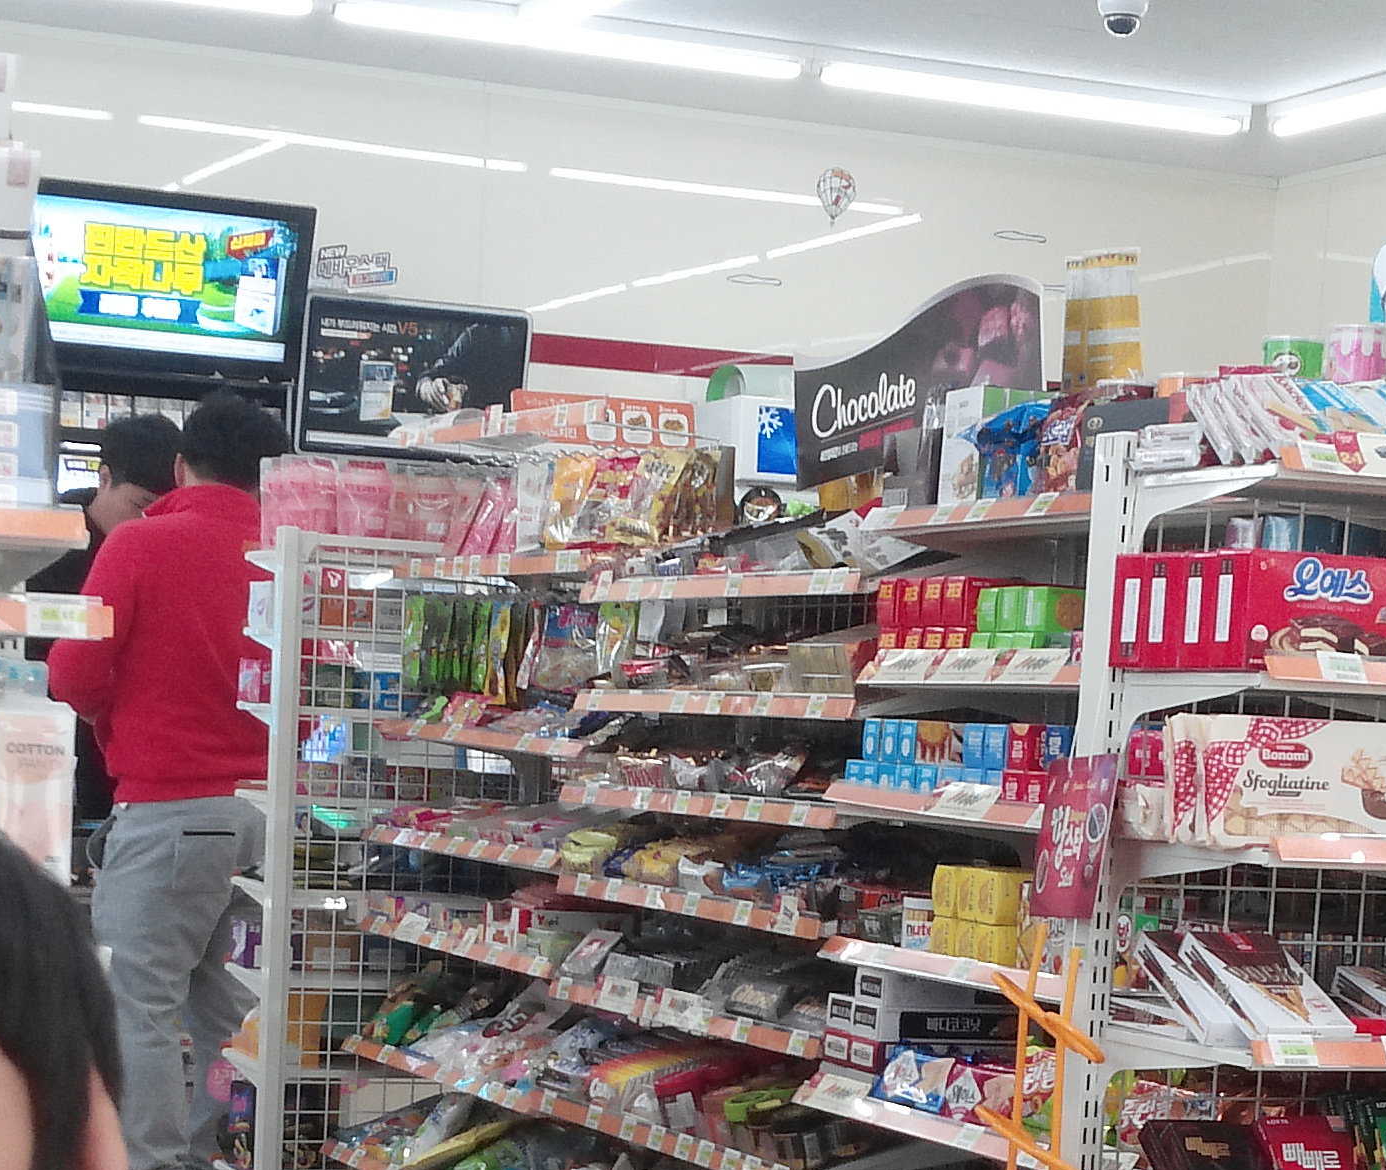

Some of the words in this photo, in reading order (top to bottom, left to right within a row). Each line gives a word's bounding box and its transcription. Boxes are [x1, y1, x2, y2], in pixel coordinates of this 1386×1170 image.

[320, 247, 347, 259] NEW
[812, 372, 916, 438] Chocolate
[1285, 558, 1372, 603] 오예스
[6, 743, 66, 759] COTTON
[1262, 748, 1311, 762] Bonomi
[1242, 769, 1330, 796] Sfogliatine
